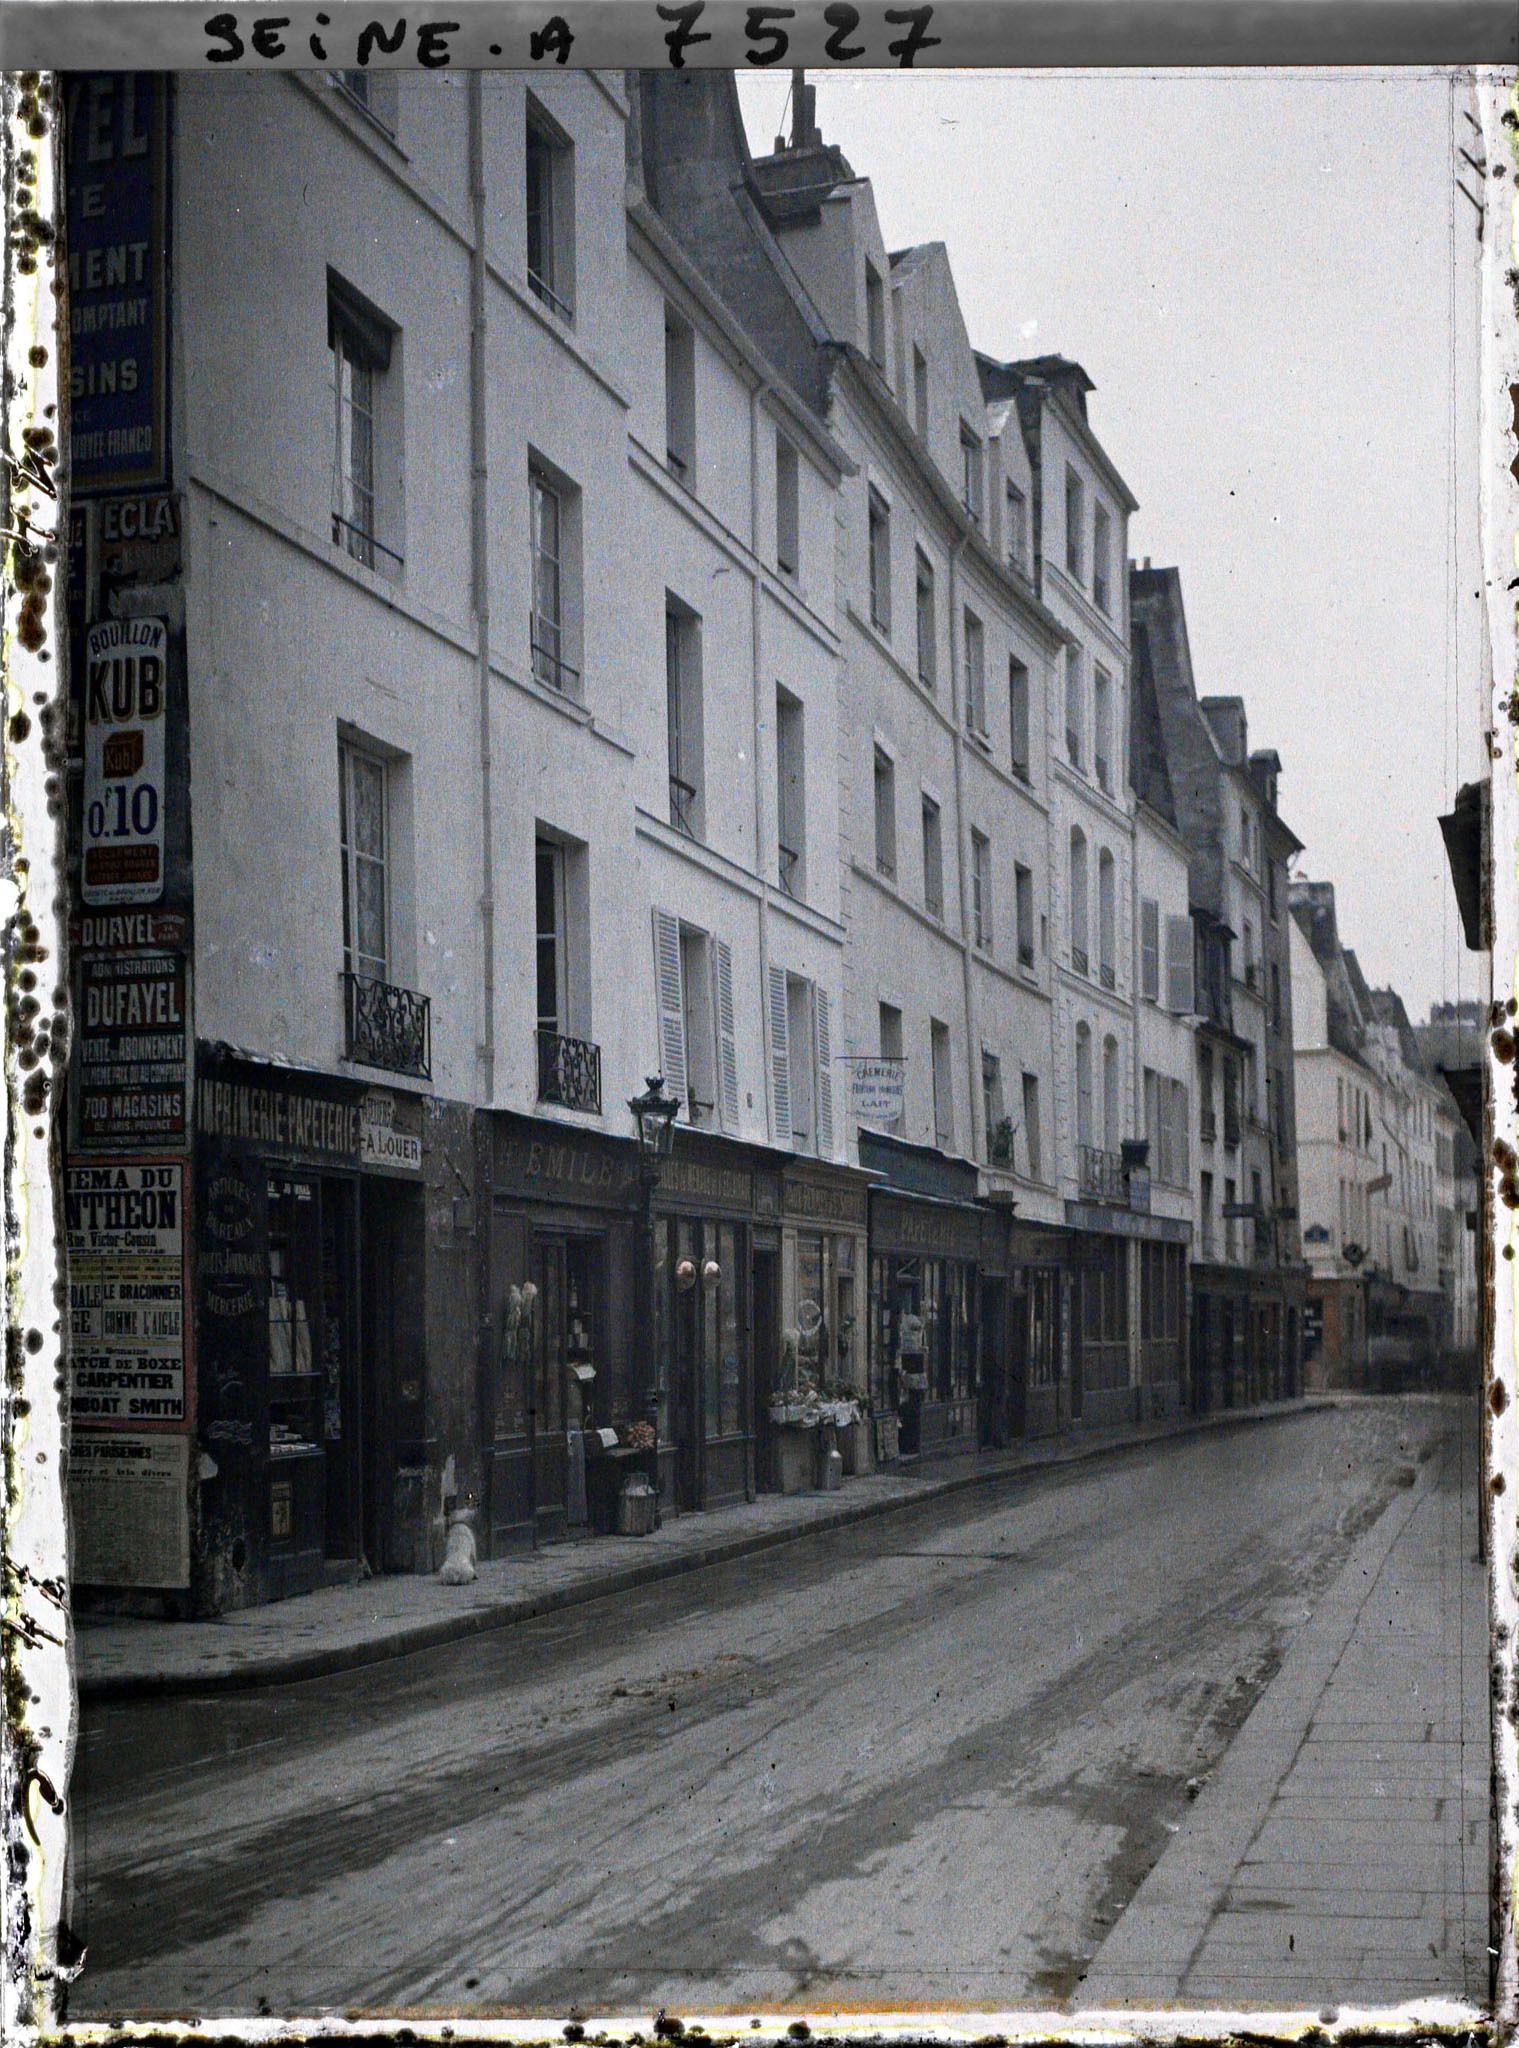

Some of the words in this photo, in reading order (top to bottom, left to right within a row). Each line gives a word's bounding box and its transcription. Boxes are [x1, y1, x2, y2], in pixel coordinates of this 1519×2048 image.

[656, 3, 942, 67] 7527
[107, 425, 153, 456] FRANCO
[90, 623, 163, 655] BOUILLON
[90, 656, 163, 724] KUB
[82, 914, 155, 948] DUFAYEL
[87, 982, 180, 1027] DUFAYEL
[111, 1093, 181, 1119] MAGASINS
[366, 1133, 375, 1154] A
[377, 1130, 419, 1161] LOUER
[141, 1168, 173, 1189] DU
[104, 1284, 115, 1300] LE
[115, 1358, 133, 1370] DE
[137, 1357, 182, 1371] BOXE
[76, 1371, 174, 1390] CARPENTIER
[129, 1398, 183, 1417] SMITH
